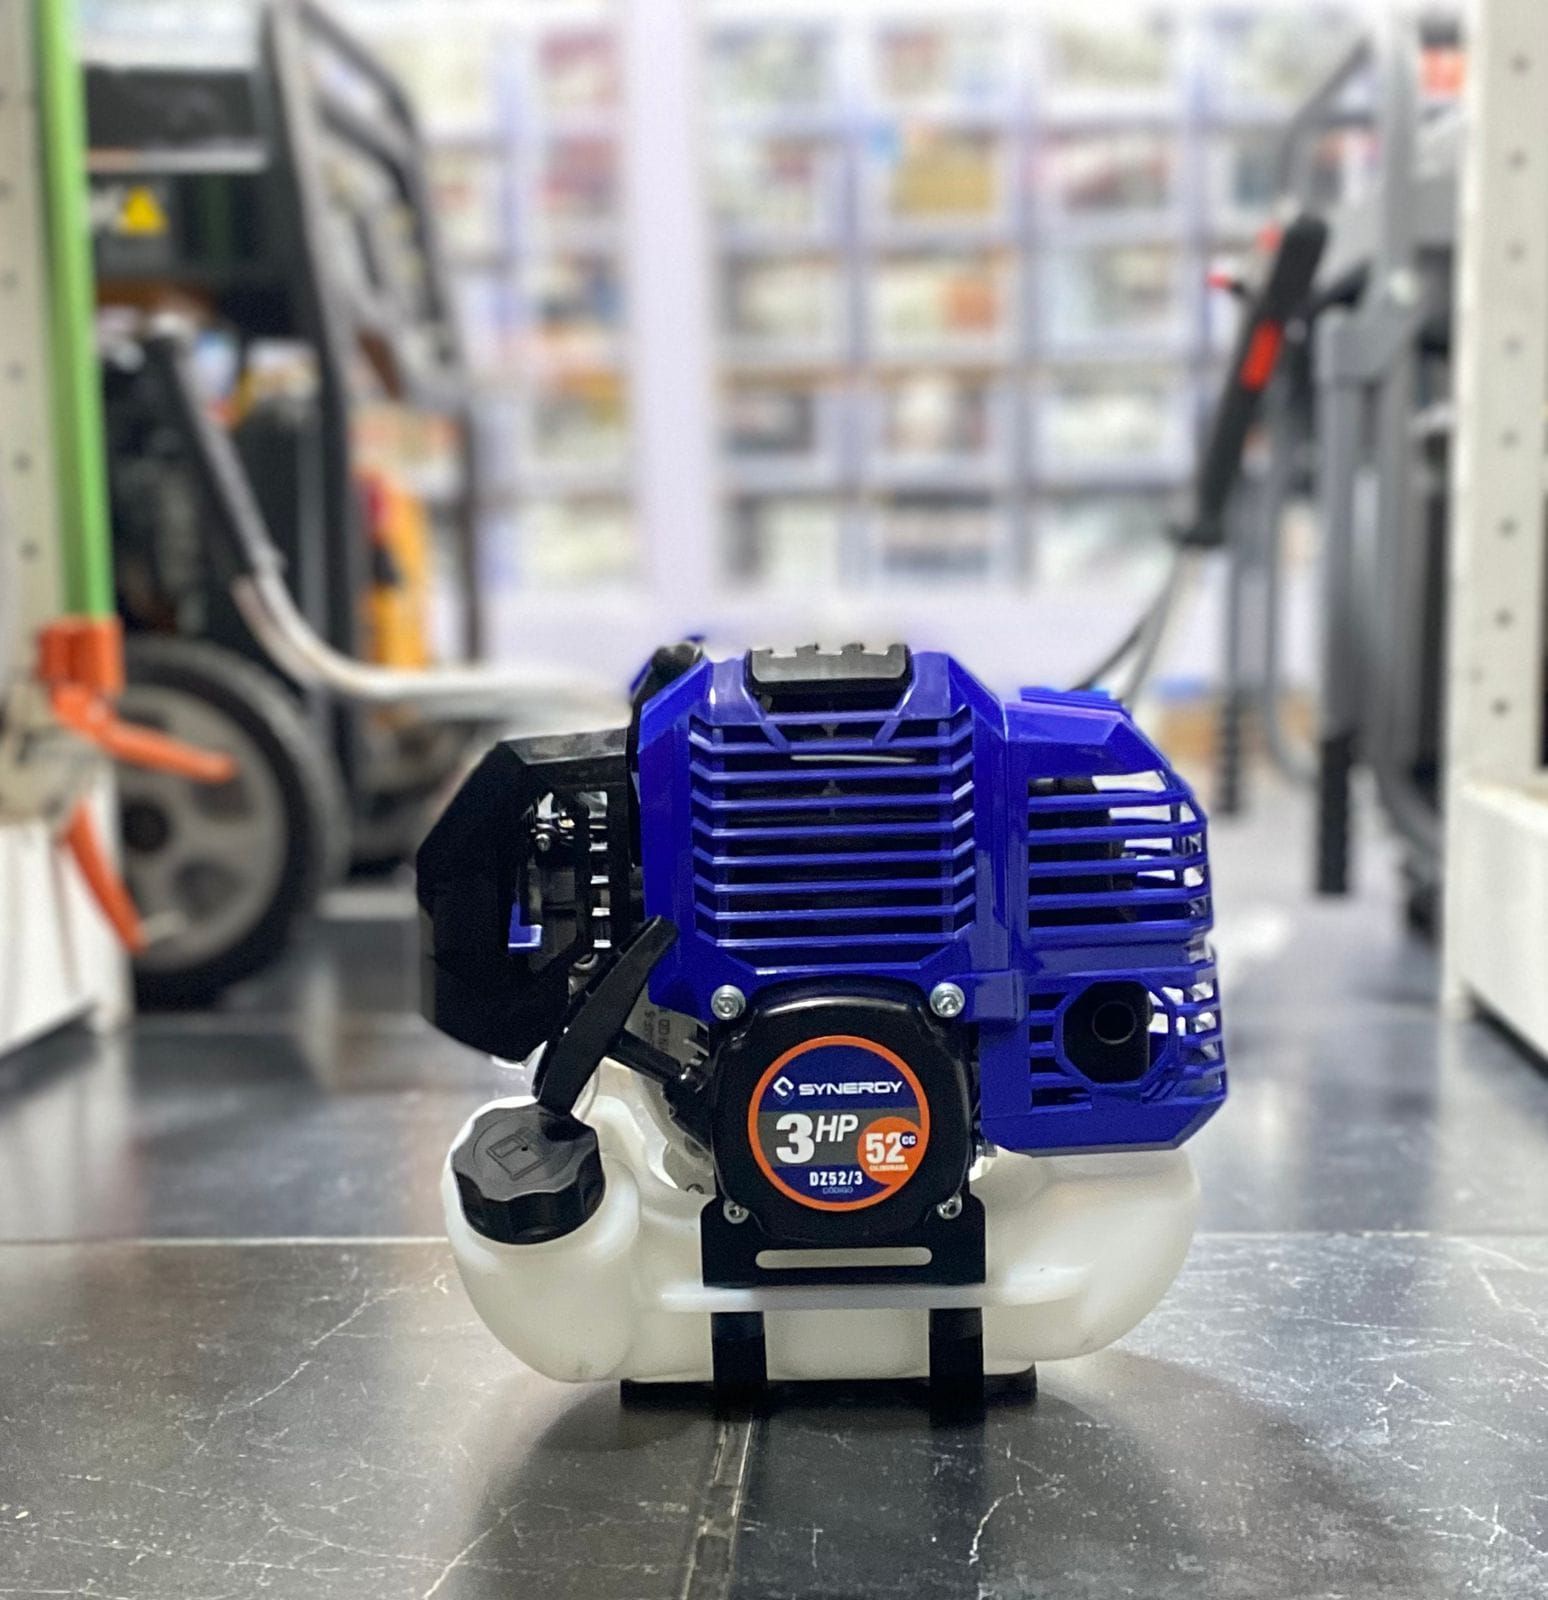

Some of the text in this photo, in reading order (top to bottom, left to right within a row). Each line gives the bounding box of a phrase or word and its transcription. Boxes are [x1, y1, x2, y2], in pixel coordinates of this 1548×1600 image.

[799, 1081, 902, 1095] SYNERGY
[776, 1113, 859, 1163] 3 HP
[865, 1132, 905, 1164] 52
[809, 1171, 863, 1186] DZ52/3
